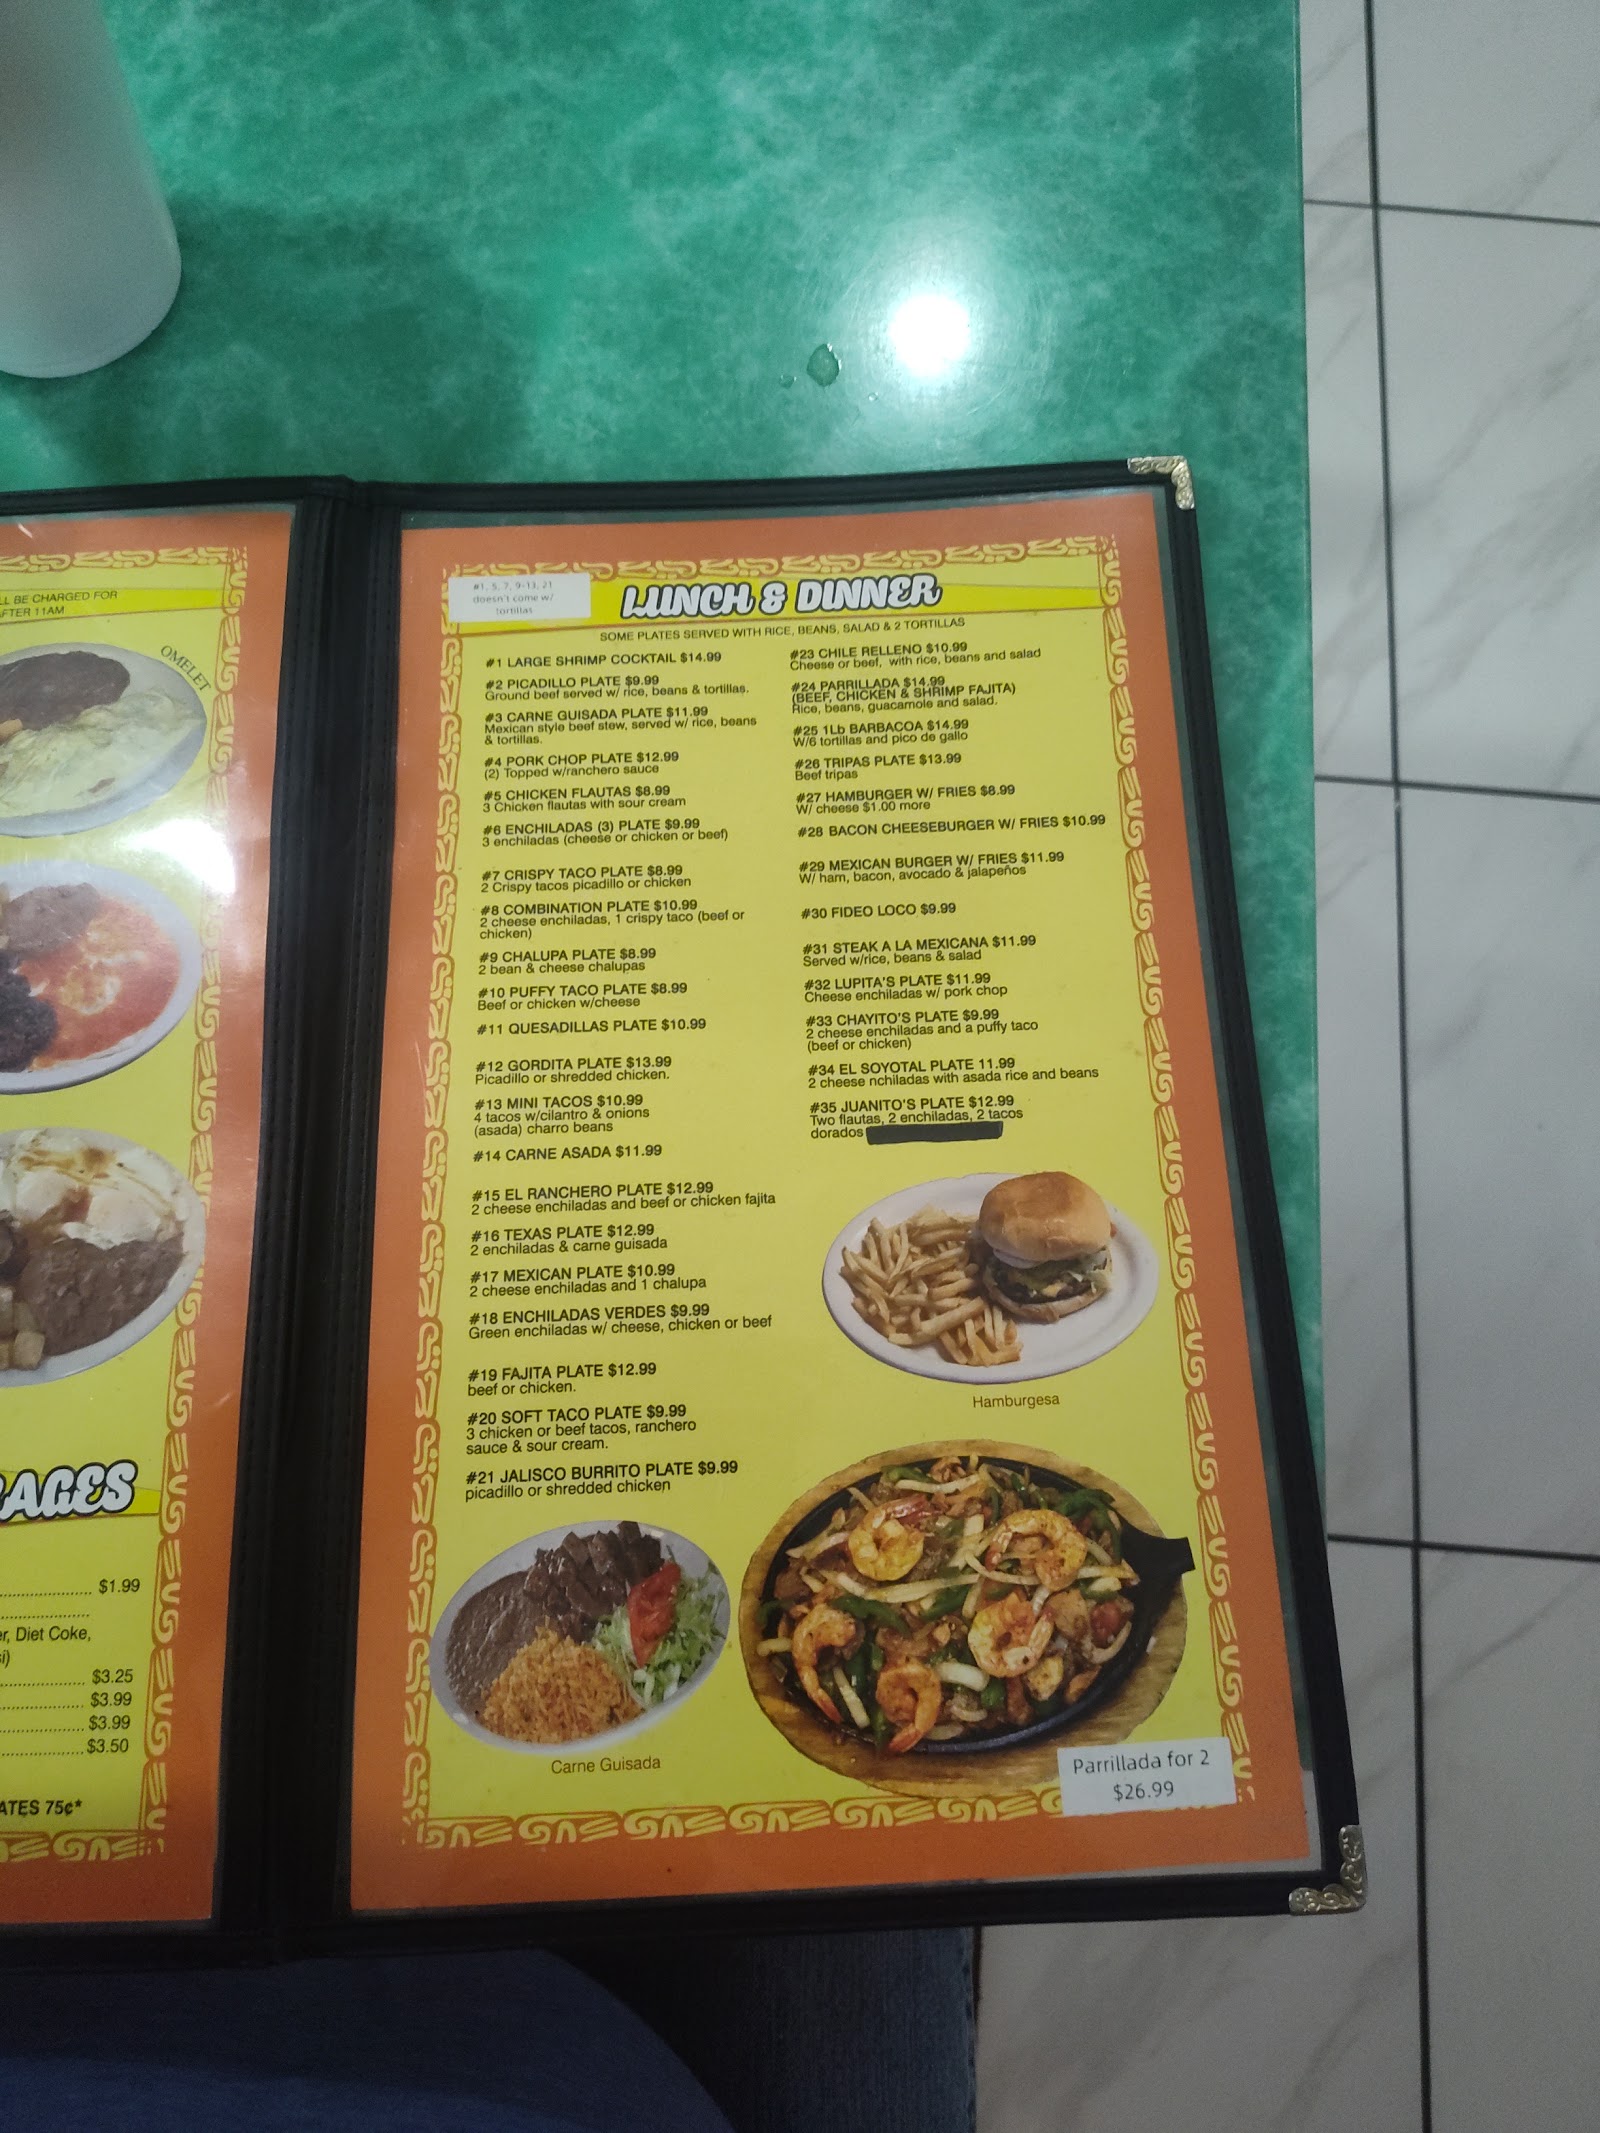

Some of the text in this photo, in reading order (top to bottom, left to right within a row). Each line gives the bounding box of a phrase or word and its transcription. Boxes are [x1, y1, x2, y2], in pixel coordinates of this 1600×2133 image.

[14, 595, 29, 605] BE
[32, 591, 91, 604] CHARGED
[93, 590, 119, 601] FOR
[473, 594, 554, 604] doesn't come w/
[620, 574, 943, 620] LUNCH & DINNER
[35, 605, 65, 616] 11AM
[496, 606, 533, 616] tortillas
[599, 616, 965, 642] SOME PLATES SERVED WITH RICE, BEANS, SALAD & 2 TORTILLAS
[485, 650, 722, 669] #1 LARGE SHRIMP COCKTAIL $14.99
[789, 640, 968, 660] #23 CHILE RELLENO $10.99
[160, 645, 212, 692] OMELET
[485, 673, 659, 690] #2 PICADILLO PLATE $9.99
[484, 682, 749, 702] Ground beef served w/ rice, beans & tortillas.
[793, 718, 969, 736] #25 1Lb BARBACOA $14.99
[792, 728, 968, 748] W/6 tortillas and pico de gallo
[483, 784, 670, 802] #5 CHICKEN FLAUTAS $8.99
[797, 813, 1106, 838] #28 BACON CHEESEBURGER W/ FRIES $10.99
[480, 898, 698, 916] #8 COMBINATION PLATE $10.99
[801, 901, 956, 919] #30 FIDEO LOCO $9.99
[802, 934, 1036, 955] #31 STEAK A LA MEXICANA $11.99
[802, 947, 982, 967] Served w/rice, beans & salad
[477, 1017, 706, 1035] #11 QUESADILLAS PLATE $10.99
[805, 1007, 999, 1027] #33 CHAYITO'S PLATE $9.99
[474, 1092, 643, 1111] #13 MINI TACOS $10.99
[809, 1093, 1014, 1114] #35 JUANITO'S PLATE $12.99
[474, 1118, 613, 1139] (asada) charro beans
[810, 1124, 863, 1139] dorados
[473, 1143, 662, 1162] #14 CARNE ASADA $11.99
[471, 1222, 655, 1243] #16 TEXAS PLATE $12.99
[469, 1302, 710, 1326] #18 ENCHILADAS VERDES $9.99
[972, 1394, 1061, 1410] Hamburgesa
[467, 1403, 687, 1426] #20 SOFT TACO PLATE $9.99
[466, 1459, 738, 1485] #21 JALISCO BURRITO PLATE $9.99
[0, 1459, 139, 1523] AGES
[465, 1476, 671, 1503] picadillo or shredded chicken
[99, 1579, 141, 1595] $1.99
[16, 1626, 44, 1642] Diet
[49, 1626, 91, 1643] Coke,
[92, 1669, 134, 1686] $3.25
[90, 1692, 133, 1708] $3.99
[89, 1715, 131, 1731] $3.99
[87, 1738, 129, 1755] $3.50
[551, 1755, 662, 1775] Carne Guisada
[1073, 1749, 1210, 1775] Parrillada for 2
[1113, 1780, 1175, 1802] $26.99
